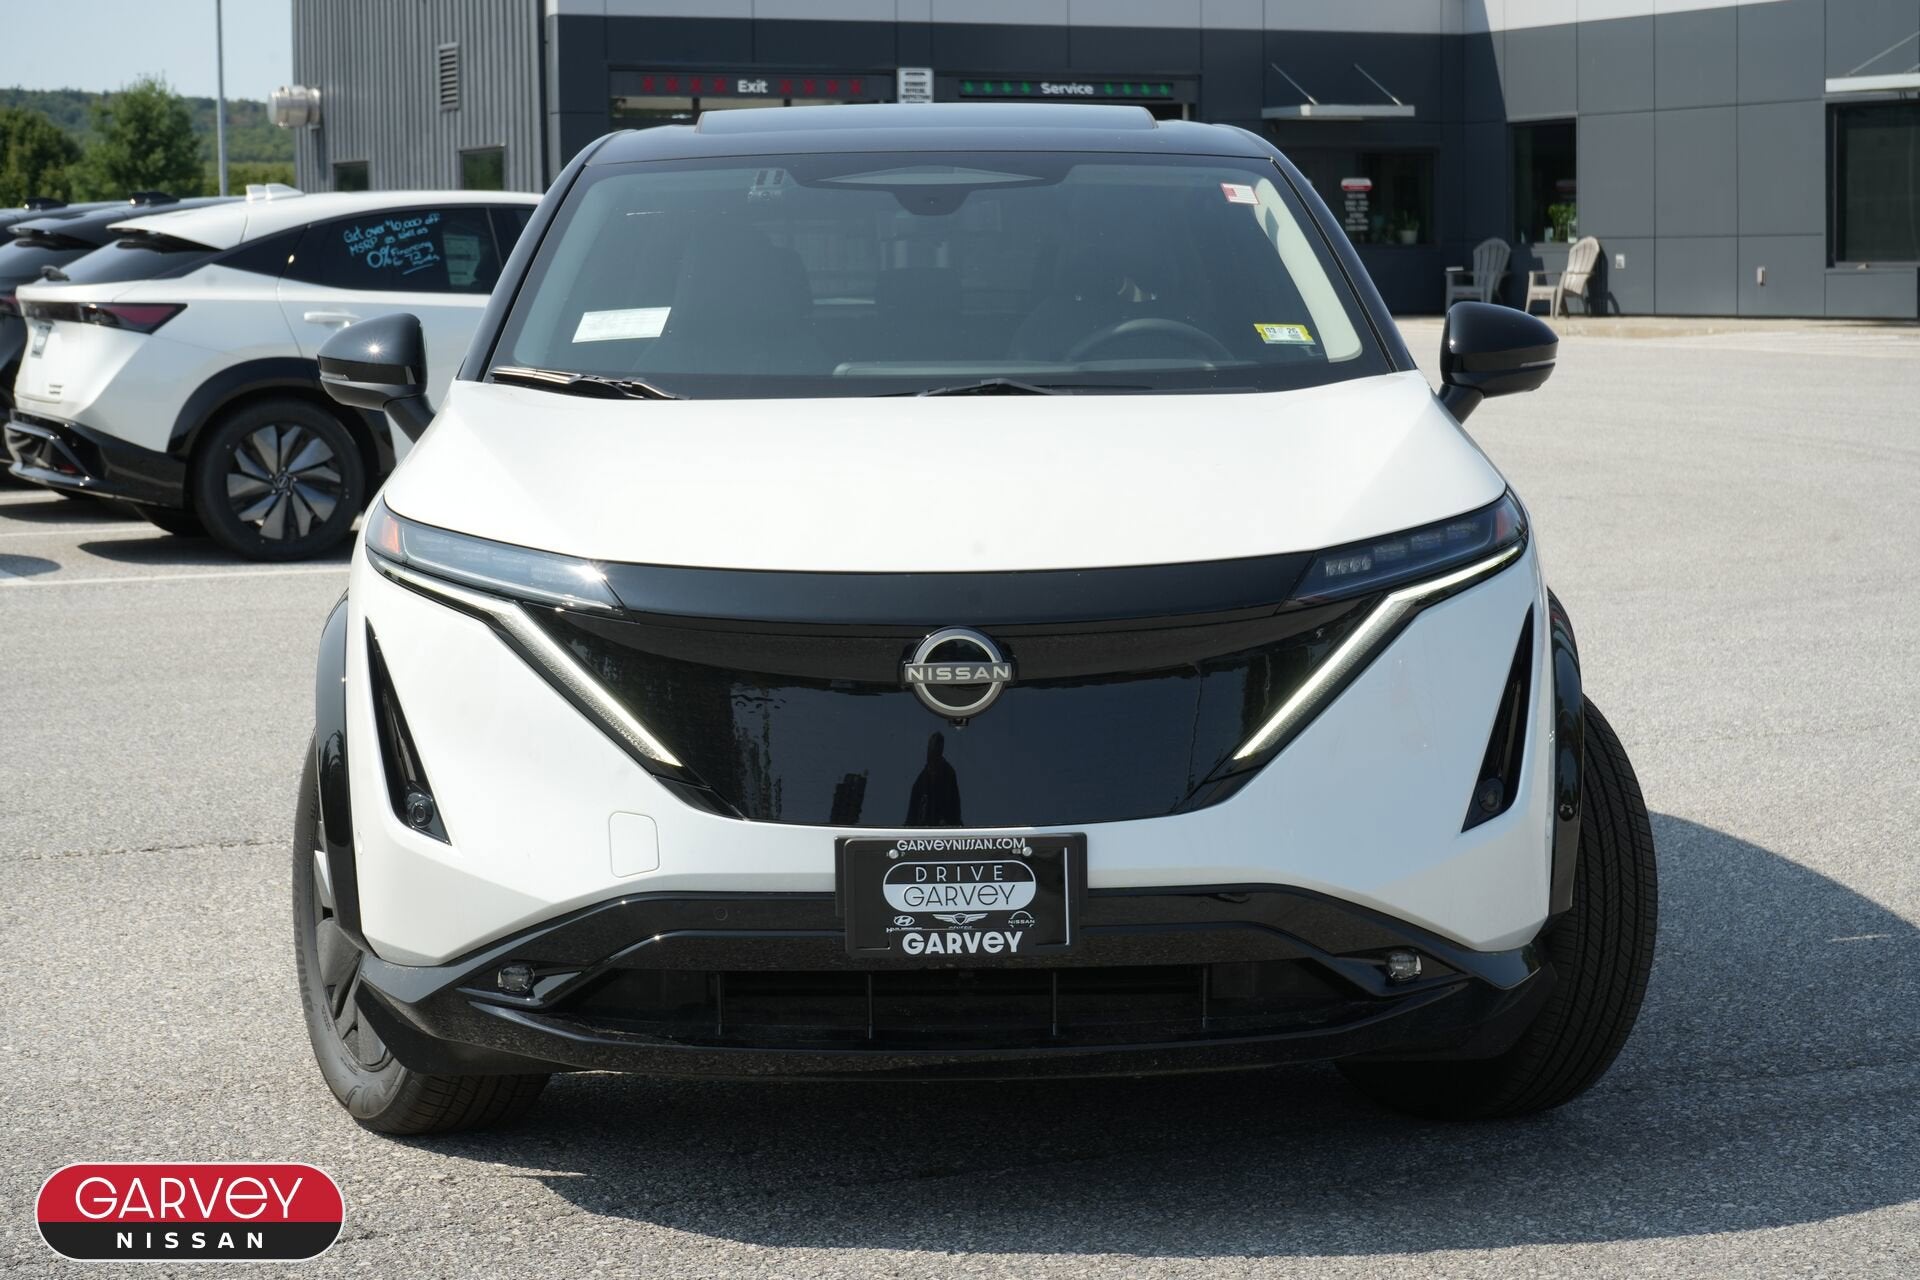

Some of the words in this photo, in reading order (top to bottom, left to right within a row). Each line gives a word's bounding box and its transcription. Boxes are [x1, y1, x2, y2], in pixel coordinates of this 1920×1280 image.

[737, 79, 769, 94] Exit
[1040, 82, 1095, 95] Service
[344, 227, 363, 243] Get
[349, 237, 378, 256] MSRP
[366, 244, 392, 269] 0%
[907, 665, 1009, 681] NISSAN
[915, 865, 1004, 882] DRIVE
